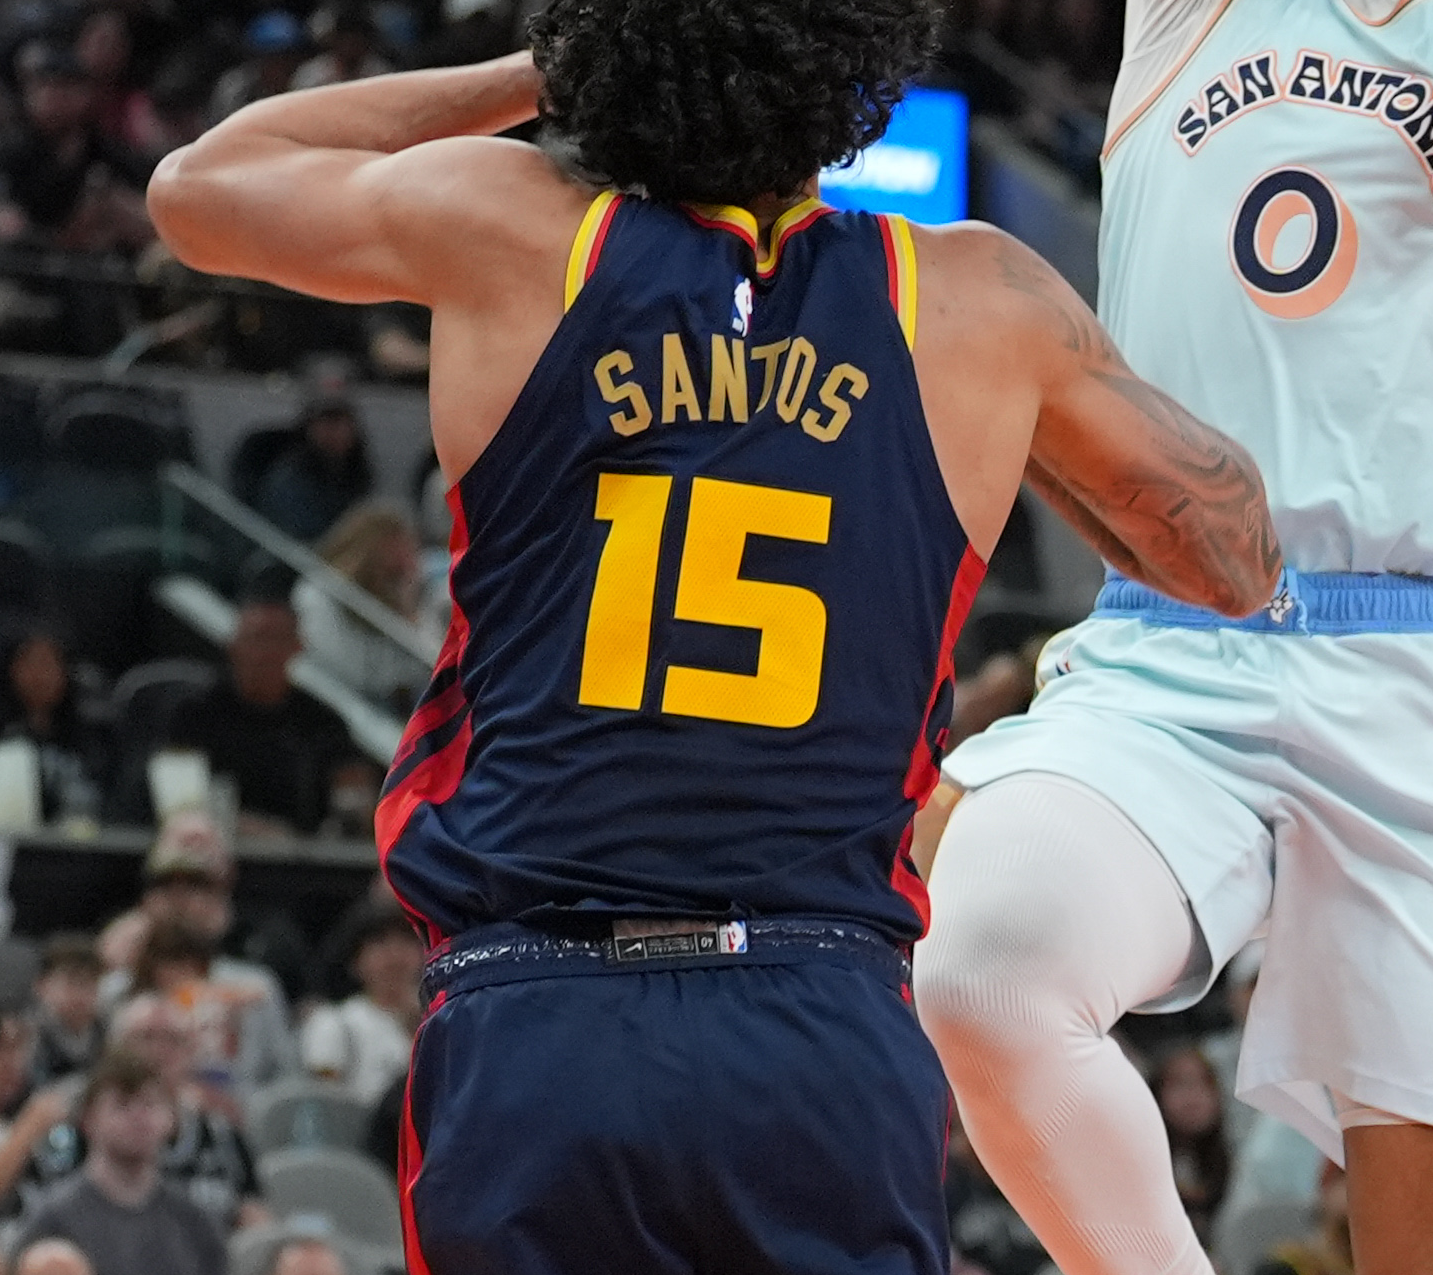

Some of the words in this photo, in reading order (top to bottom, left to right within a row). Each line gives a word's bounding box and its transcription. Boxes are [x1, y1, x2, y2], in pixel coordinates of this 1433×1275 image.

[1173, 51, 1280, 156] SAN
[1230, 166, 1354, 312] 0
[593, 332, 870, 443] SANTOS
[578, 472, 833, 729] 15
